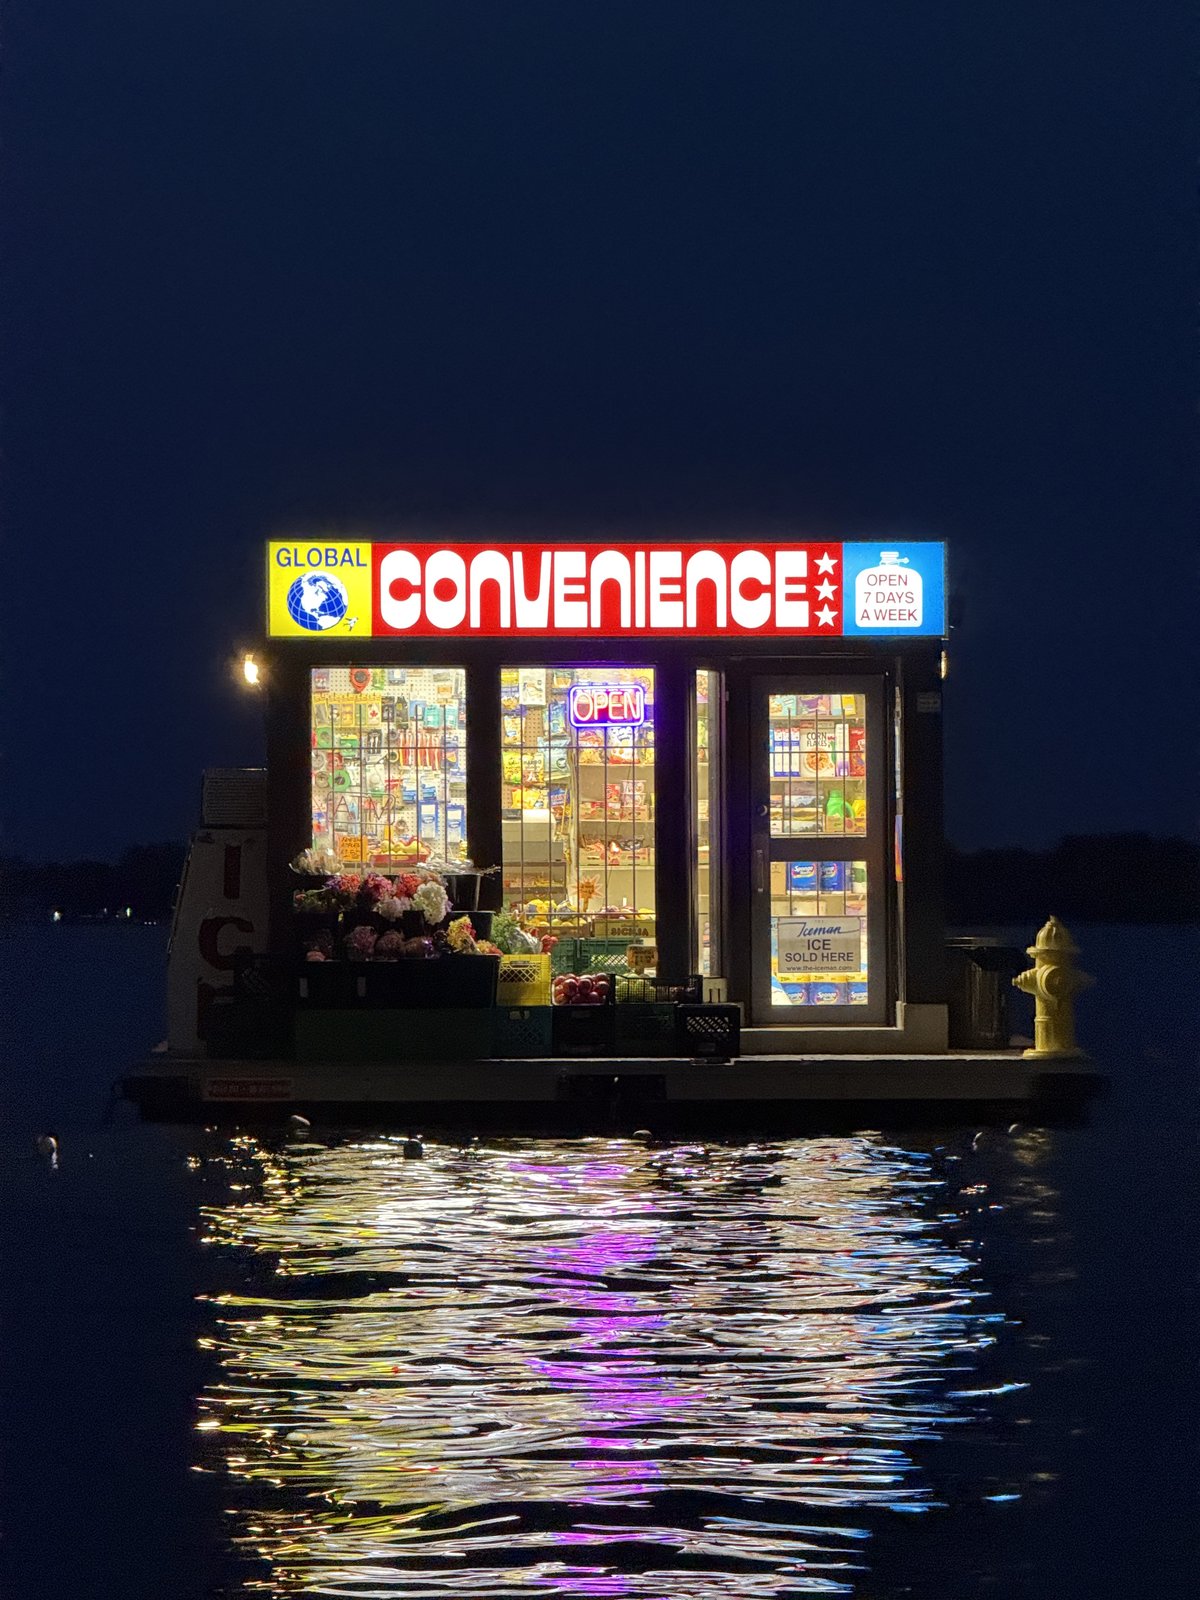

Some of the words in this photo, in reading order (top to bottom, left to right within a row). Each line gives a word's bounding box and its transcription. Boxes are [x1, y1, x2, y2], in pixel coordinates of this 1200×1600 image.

[276, 547, 367, 567] GLOBAL
[866, 574, 908, 587] OPEN
[380, 550, 809, 629] CONVENIENCE
[863, 591, 872, 604] 7
[875, 591, 915, 604] DAYS
[860, 608, 871, 621] A
[874, 608, 918, 621] WEEK
[573, 691, 641, 721] OPEN
[806, 732, 827, 741] CORN
[333, 795, 394, 822] ATM
[778, 921, 860, 938] Iceman
[807, 939, 832, 951] ICE
[784, 952, 818, 962] SOLD
[821, 952, 854, 962] HERE
